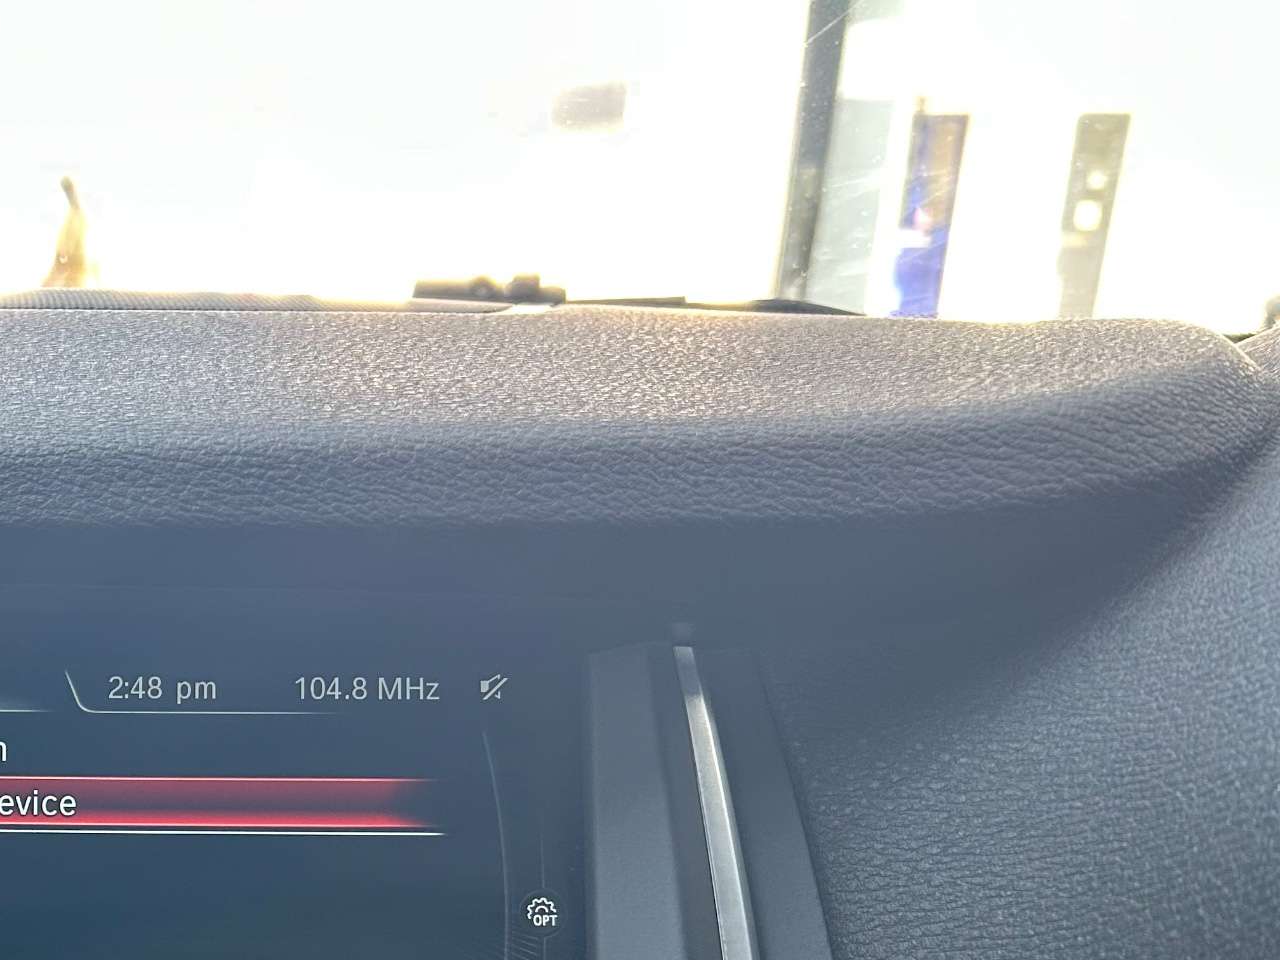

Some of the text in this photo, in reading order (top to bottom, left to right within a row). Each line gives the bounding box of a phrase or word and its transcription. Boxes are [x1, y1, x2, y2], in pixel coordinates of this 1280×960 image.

[107, 675, 217, 704] 2:48 pm
[295, 676, 440, 701] 104.8 MHz
[533, 914, 558, 926] OPT
